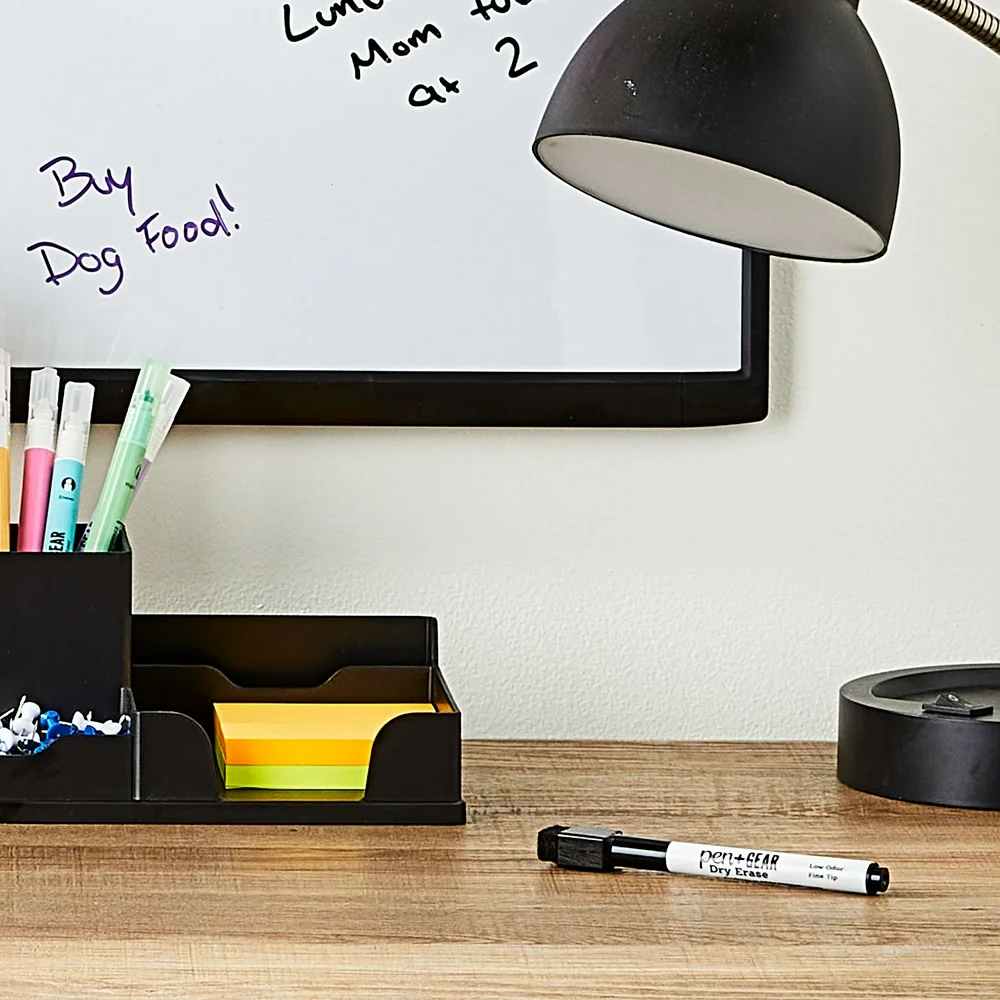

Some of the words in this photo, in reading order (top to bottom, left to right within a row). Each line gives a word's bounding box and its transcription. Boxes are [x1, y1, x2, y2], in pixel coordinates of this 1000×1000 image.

[350, 23, 442, 80] Mom
[408, 76, 460, 107] at
[495, 36, 538, 78] 2
[39, 156, 136, 216] Buy
[26, 242, 124, 295] Dog
[136, 182, 240, 253] Food!
[700, 850, 780, 871] pen+GEAR
[710, 864, 731, 876] Dry
[736, 867, 768, 879] Erase
